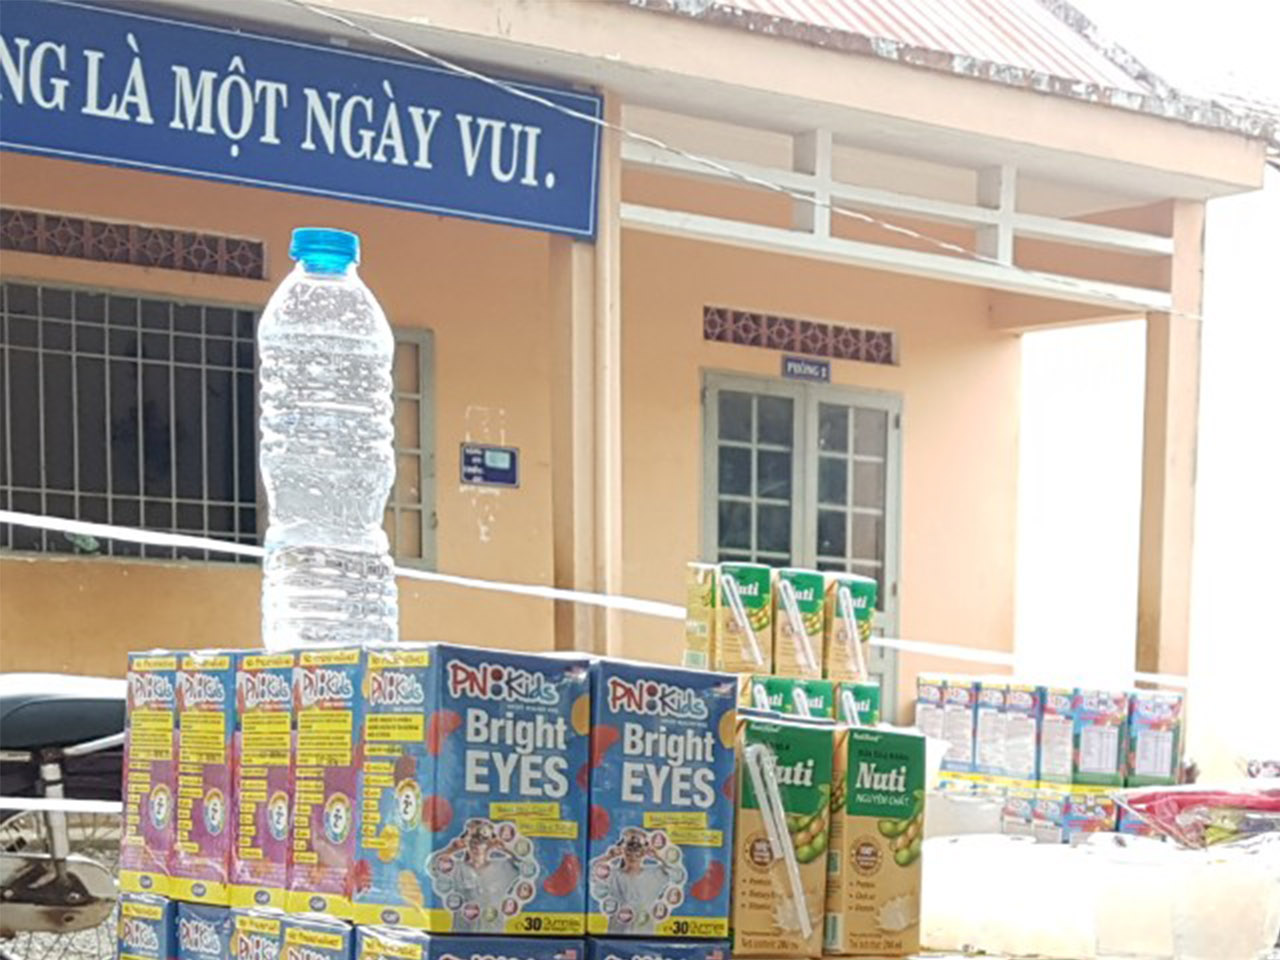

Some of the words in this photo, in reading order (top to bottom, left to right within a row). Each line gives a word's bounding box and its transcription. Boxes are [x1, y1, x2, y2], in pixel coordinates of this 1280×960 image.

[82, 33, 154, 126] LÀ
[170, 56, 288, 158] MỘT
[301, 80, 441, 169] NGÀY
[455, 114, 556, 189] VUI.
[465, 709, 567, 756] Bright
[622, 722, 715, 767] Bright
[464, 750, 569, 799] EYES
[621, 763, 715, 808] EYES
[855, 762, 908, 793] Nuti
[523, 917, 542, 931] 30
[672, 921, 689, 935] 30
